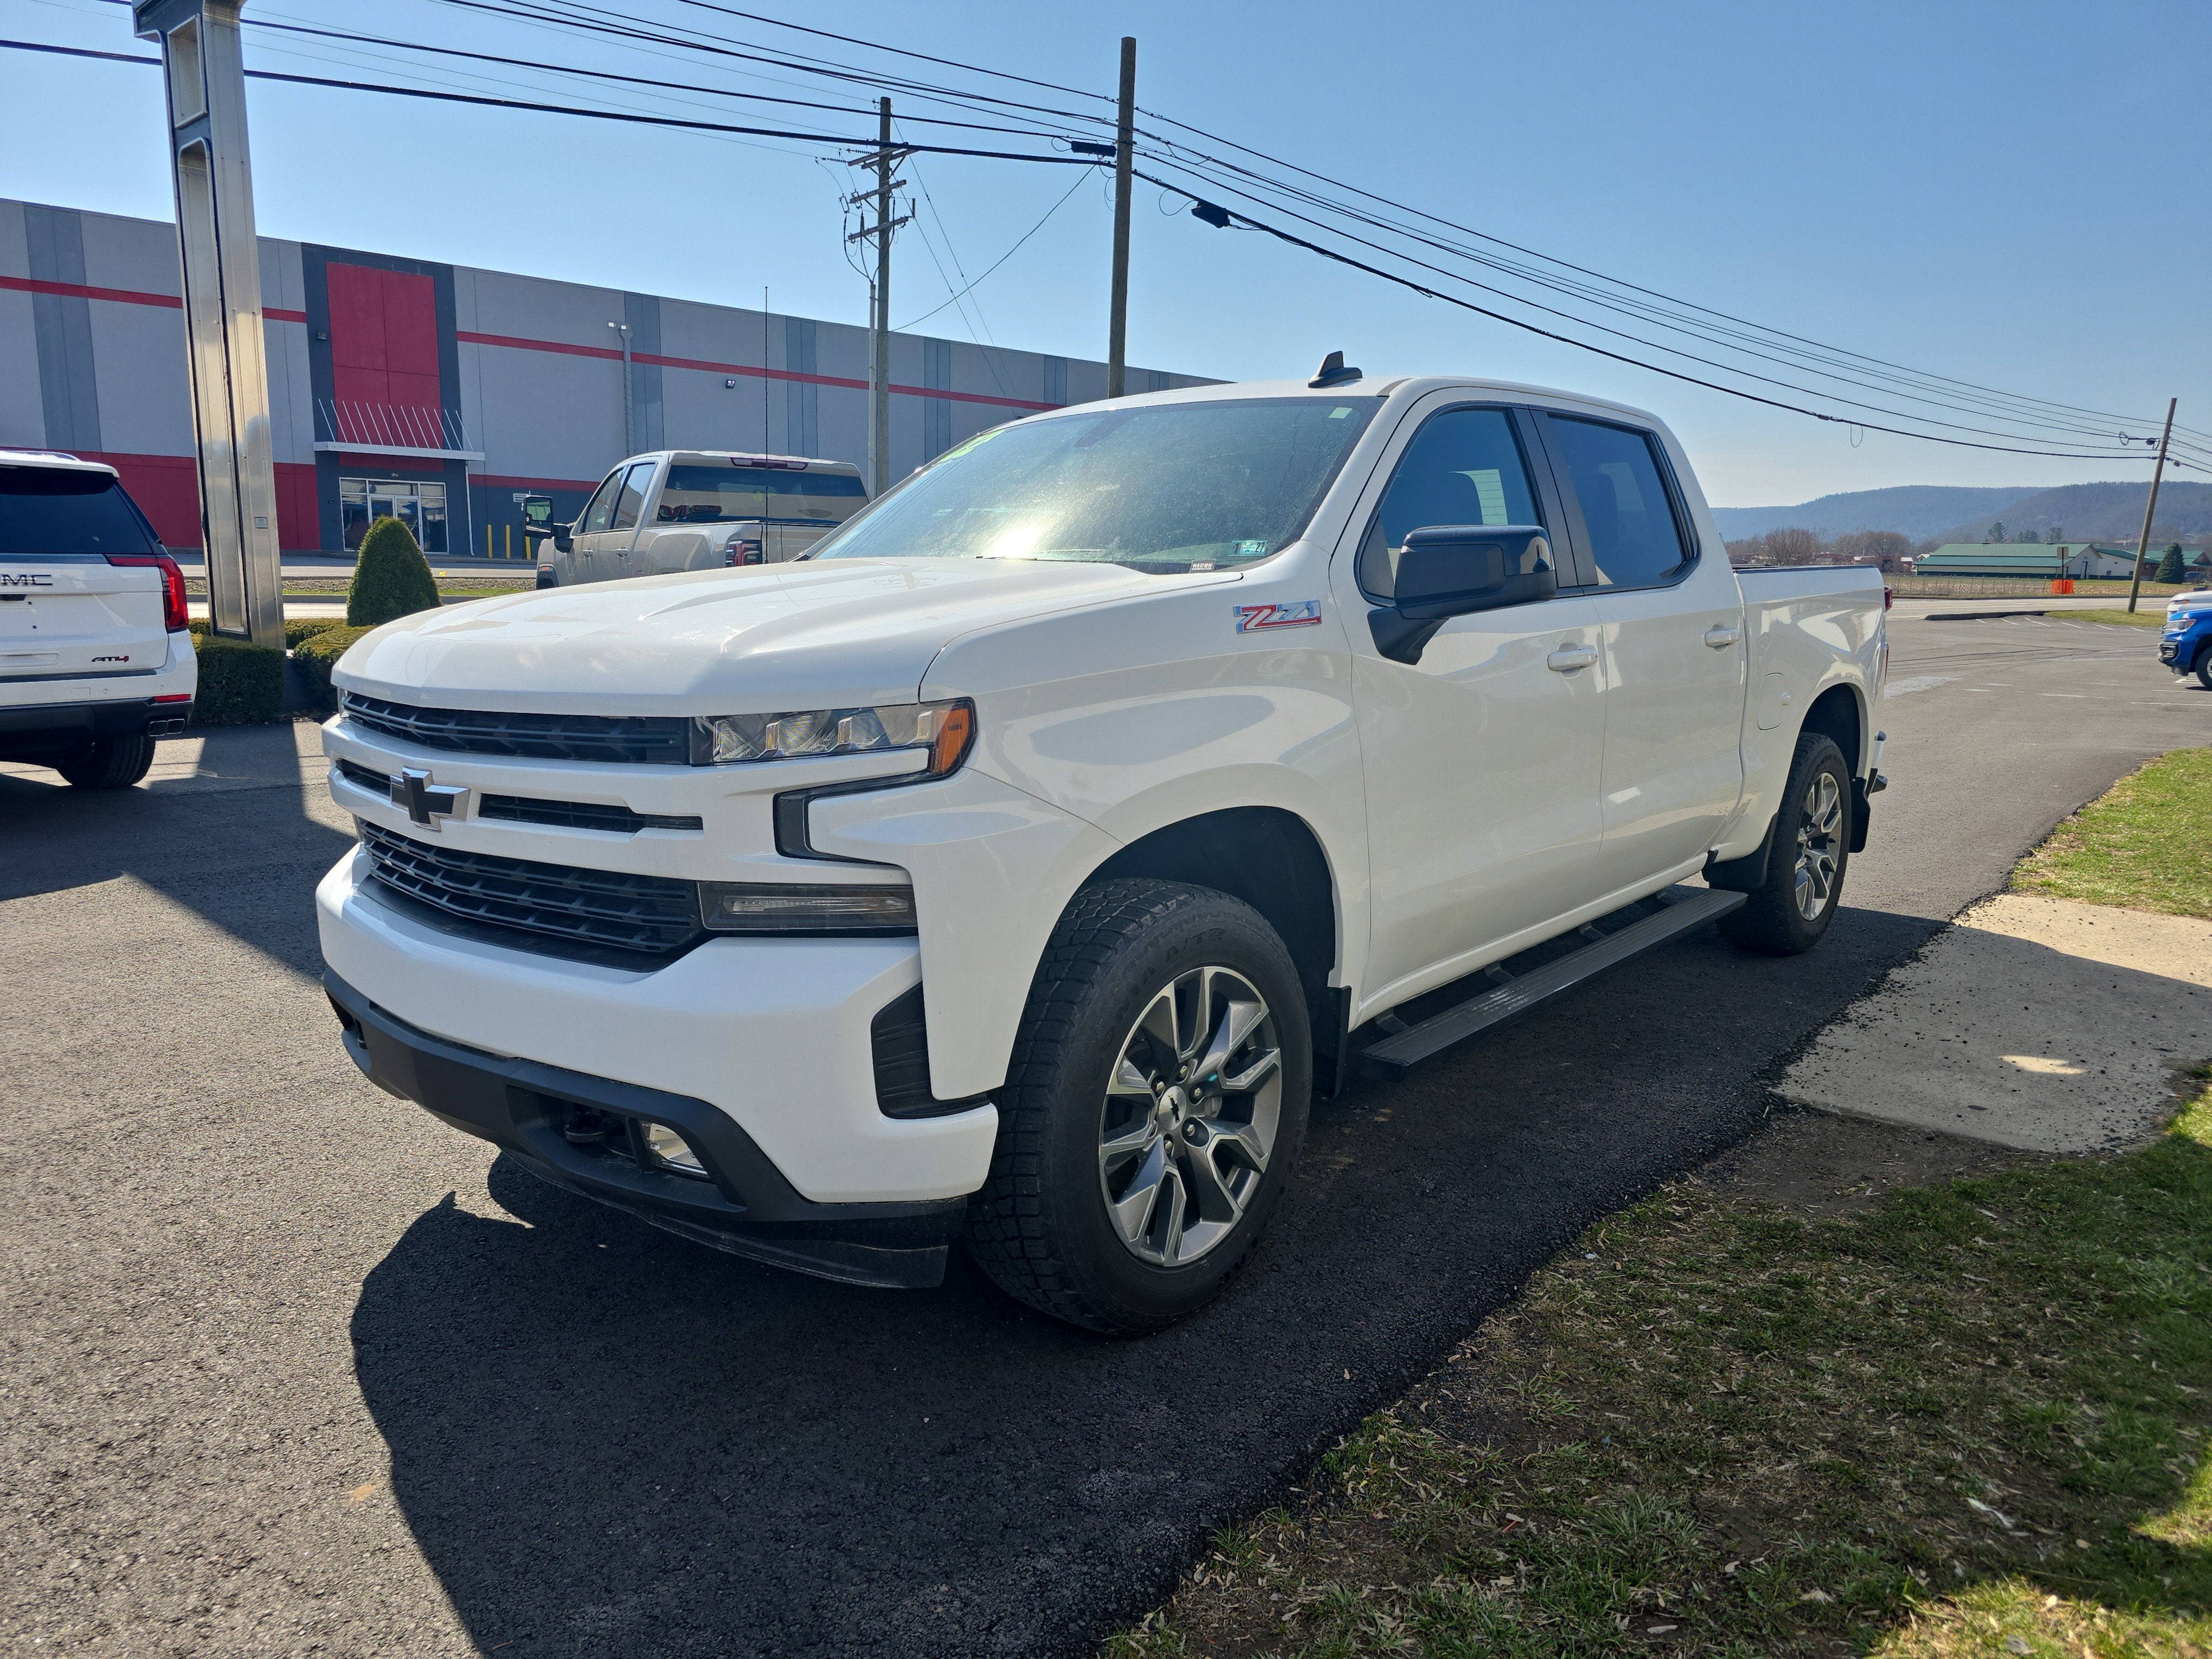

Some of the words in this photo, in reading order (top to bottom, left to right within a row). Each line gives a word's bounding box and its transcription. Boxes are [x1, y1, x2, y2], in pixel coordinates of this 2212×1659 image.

[1255, 542, 1265, 553] 27
[0, 574, 53, 586] MC
[1233, 599, 1322, 634] Z71
